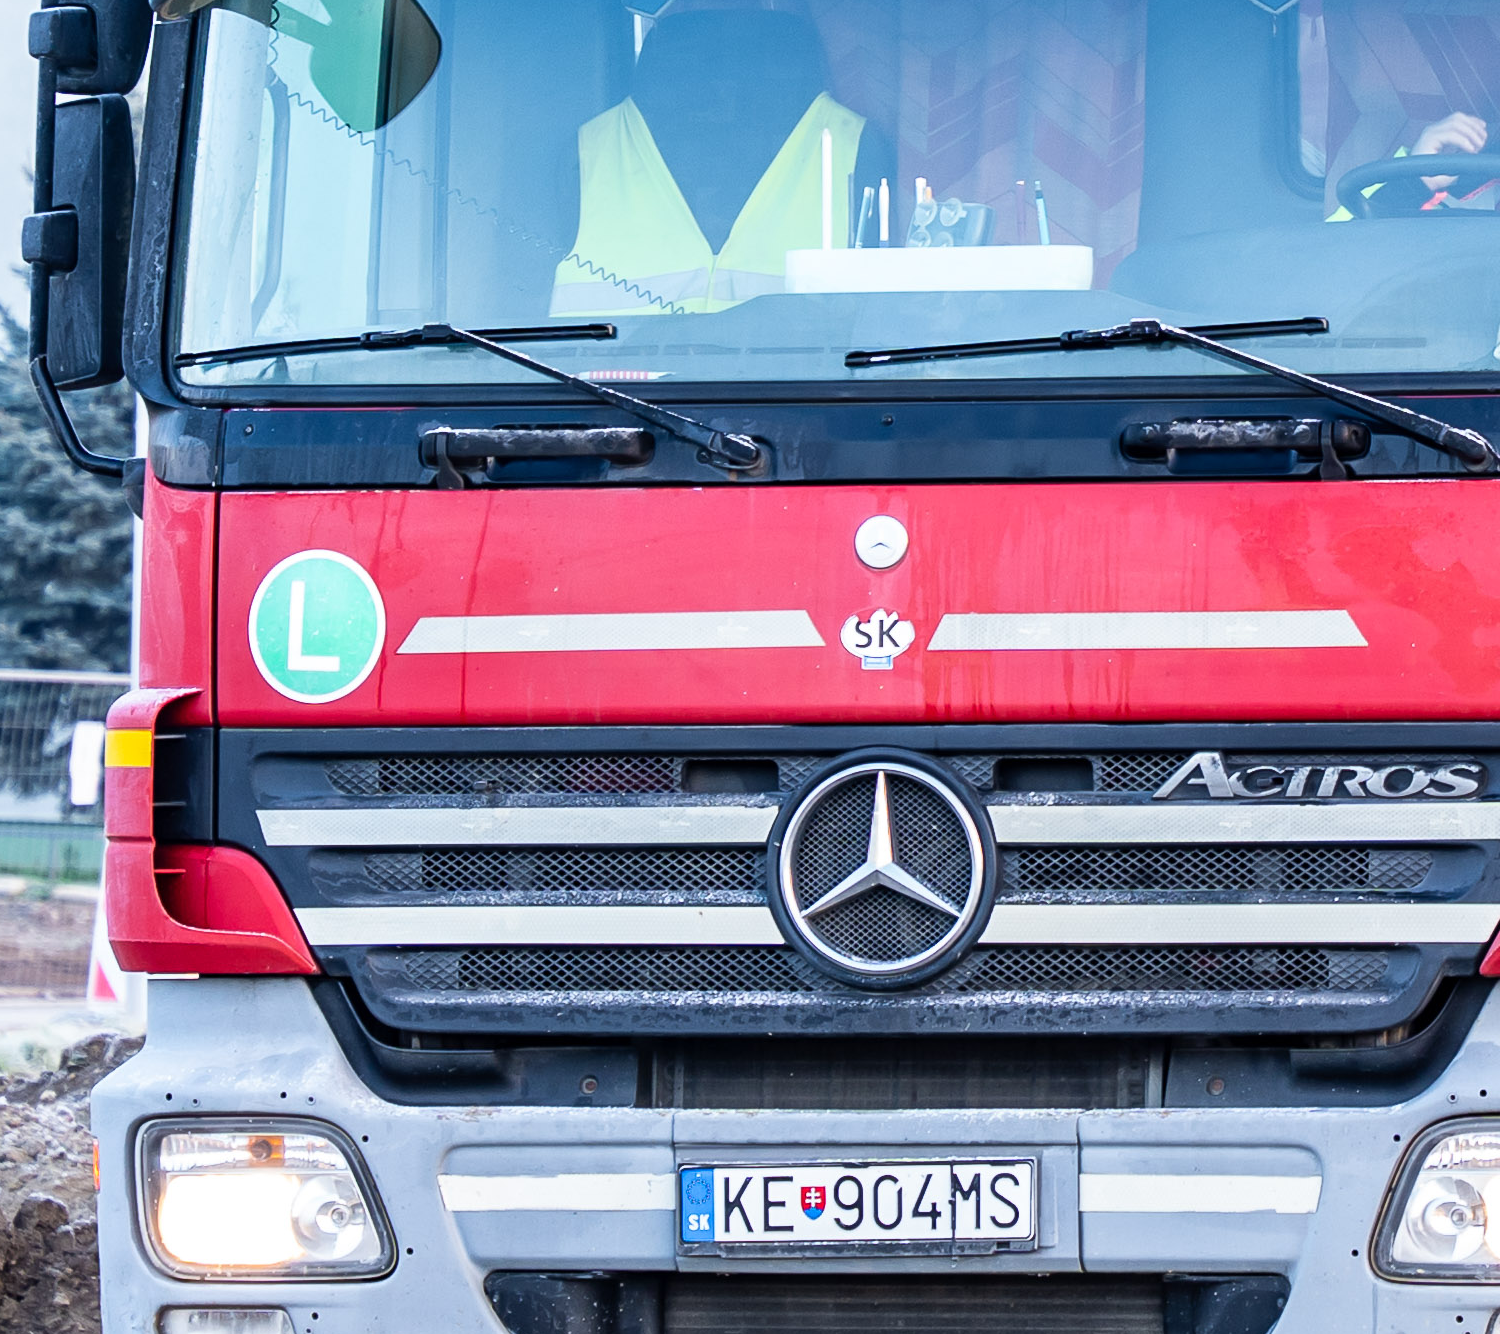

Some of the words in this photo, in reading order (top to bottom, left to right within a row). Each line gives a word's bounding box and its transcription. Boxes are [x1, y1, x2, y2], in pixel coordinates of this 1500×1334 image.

[287, 580, 341, 671] L
[855, 619, 900, 649] SK
[1152, 751, 1484, 799] ACTROS
[688, 1213, 711, 1232] SK
[723, 1175, 794, 1233] KE
[832, 1172, 1021, 1232] 904MS
